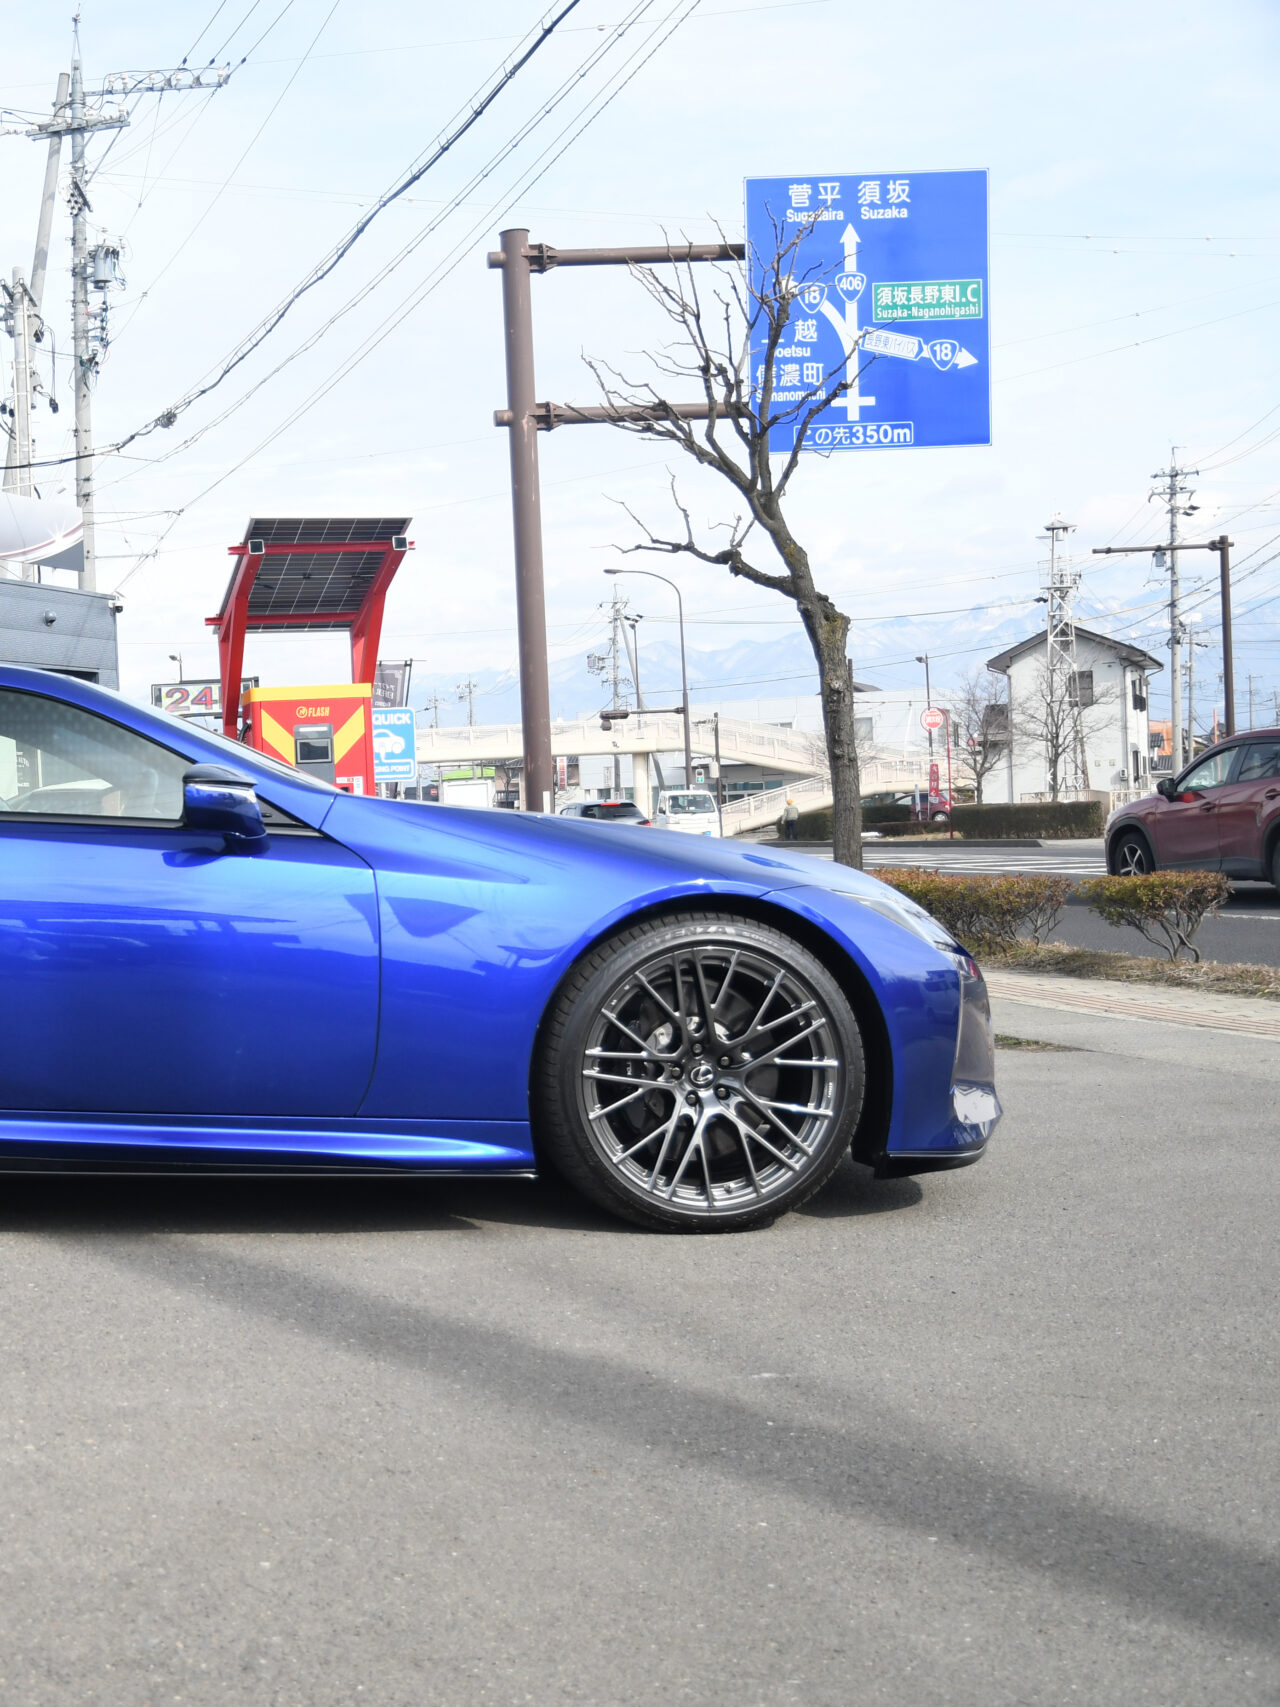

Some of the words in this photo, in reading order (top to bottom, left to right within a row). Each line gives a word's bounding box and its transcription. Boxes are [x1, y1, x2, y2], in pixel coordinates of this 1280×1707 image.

[788, 182, 841, 207] 菅平
[858, 180, 911, 204] 須坂
[860, 205, 908, 219] Suzaka
[840, 276, 862, 290] 406
[804, 287, 821, 304] 18
[877, 304, 979, 318] Suzaka-Naganohigashi
[761, 318, 818, 343] 越
[773, 345, 811, 358] oetsu
[933, 343, 952, 361] 18
[165, 686, 221, 712] 24
[308, 706, 330, 717] FLASH
[373, 713, 411, 725] QUICK
